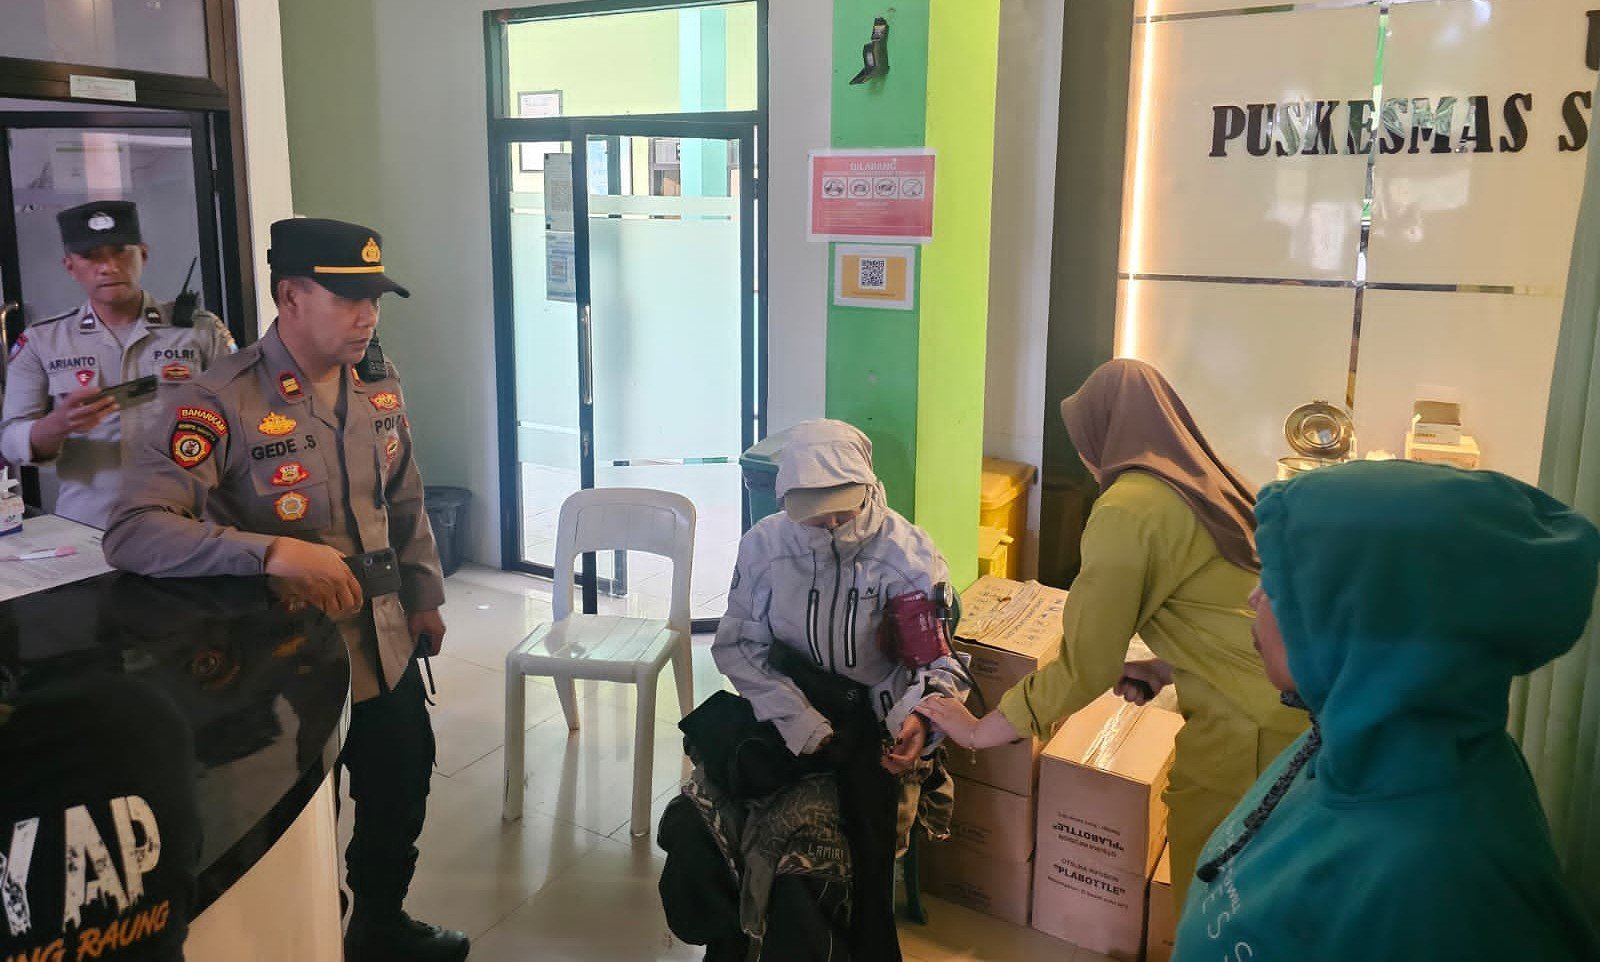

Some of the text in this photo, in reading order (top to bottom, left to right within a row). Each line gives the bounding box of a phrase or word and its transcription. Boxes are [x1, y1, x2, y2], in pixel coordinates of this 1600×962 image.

[1208, 93, 1533, 157] PUSKESMAS
[49, 356, 96, 370] ARIANTO
[153, 349, 194, 360] POLRI
[251, 438, 297, 460] GEDE
[77, 900, 170, 962] RAUNG
